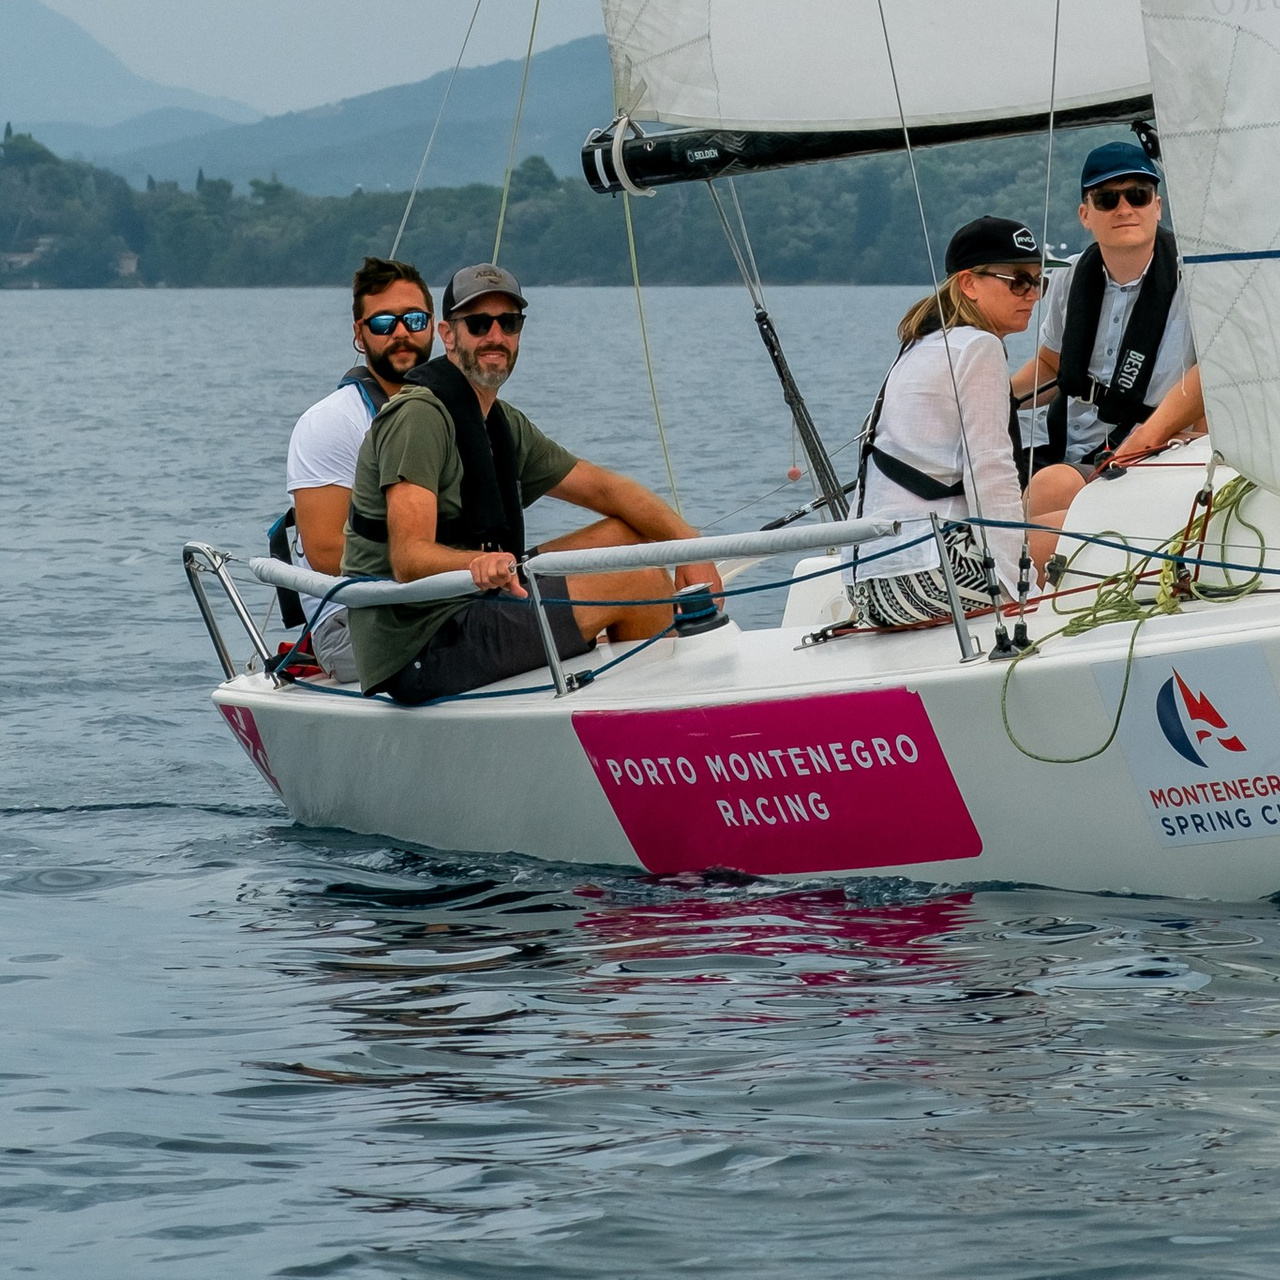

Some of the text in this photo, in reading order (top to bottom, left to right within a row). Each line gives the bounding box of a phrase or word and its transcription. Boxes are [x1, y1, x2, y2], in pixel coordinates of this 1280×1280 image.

[1117, 350, 1146, 389] BESTO
[606, 733, 919, 786] PORTO MONTENEGRO
[716, 791, 831, 827] RACING
[1161, 808, 1252, 837] SPRING
